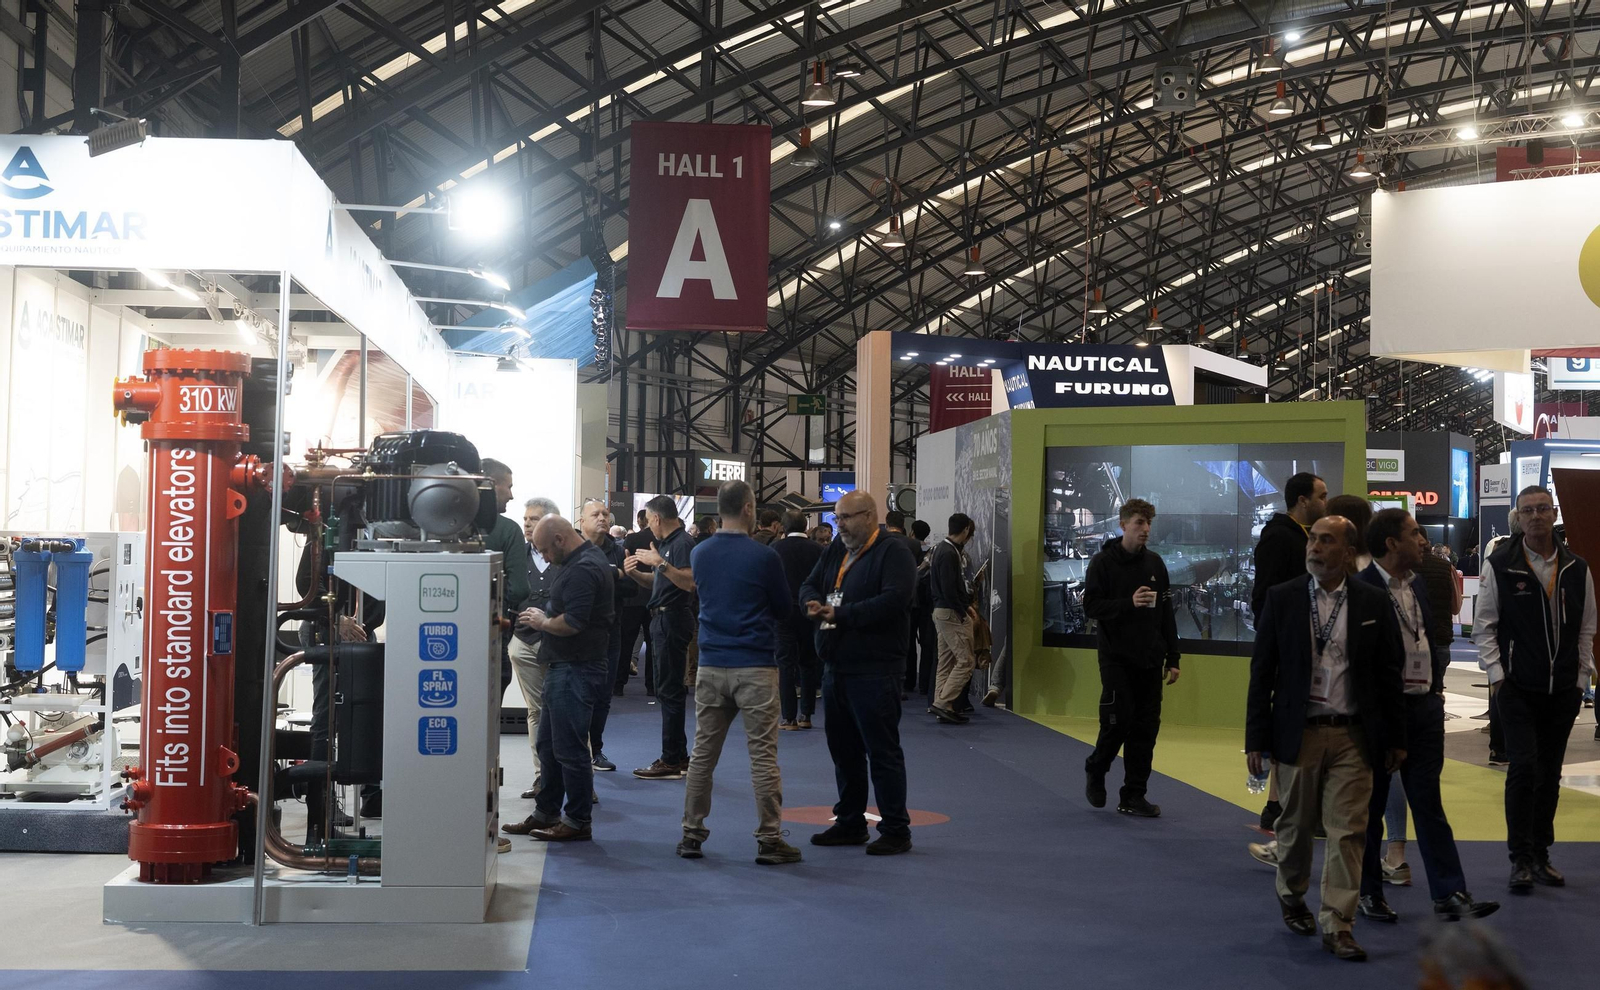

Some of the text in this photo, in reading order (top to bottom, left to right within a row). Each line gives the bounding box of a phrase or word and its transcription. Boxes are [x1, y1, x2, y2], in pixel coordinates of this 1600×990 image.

[658, 152, 743, 179] HALL 1
[656, 198, 739, 300] A
[1028, 355, 1159, 373] NAUTICAL
[949, 365, 985, 378] HALL
[1055, 382, 1169, 396] FURUNO
[179, 387, 238, 411] 310 kW
[968, 392, 991, 402] HALL
[1378, 461, 1397, 470] VIGO
[160, 447, 196, 562] elevators
[422, 587, 455, 598] R1234ze
[159, 569, 193, 678] standard
[424, 625, 454, 636] TURBO
[432, 671, 445, 681] FL
[423, 681, 454, 691] SPRAY
[157, 686, 190, 733] into
[429, 718, 447, 728] ECO
[155, 742, 189, 786] Fits
